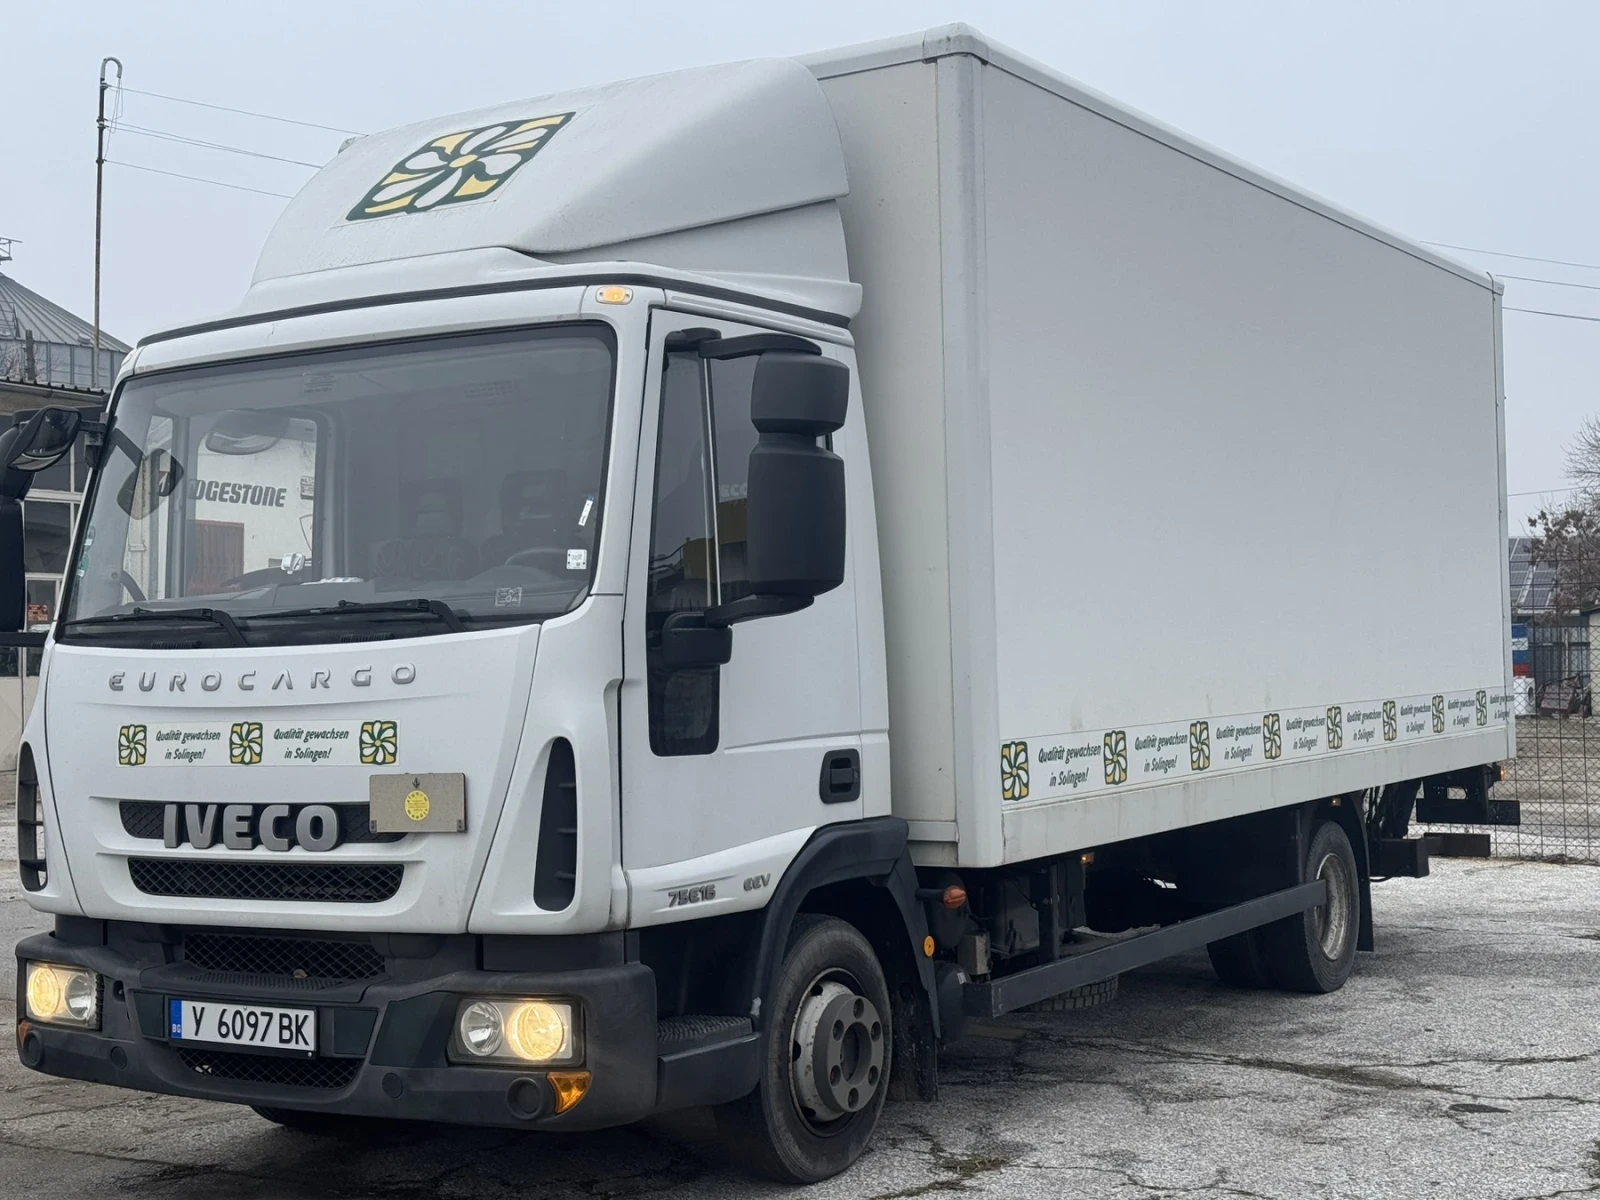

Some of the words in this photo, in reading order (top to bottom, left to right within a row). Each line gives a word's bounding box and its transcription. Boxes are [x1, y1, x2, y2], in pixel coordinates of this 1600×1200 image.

[188, 479, 288, 507] DGESTONE
[108, 663, 417, 692] EUROCARGO
[156, 729, 182, 742] Qualität
[181, 729, 221, 744] gewachsen
[273, 728, 304, 740] Qualität
[304, 728, 349, 743] gewachsen
[1135, 734, 1157, 751] Qualität
[1157, 732, 1188, 752] gewachsen
[164, 748, 172, 759] in
[173, 748, 206, 763] Solingen!
[284, 747, 292, 758] in
[294, 747, 332, 762] Solingen!
[1038, 745, 1065, 763] Qualität
[1065, 742, 1101, 764] gewachsen
[1224, 747, 1229, 760] in
[1144, 758, 1150, 772] in
[1151, 754, 1177, 774] Solingen!
[1050, 772, 1056, 787] in
[1058, 767, 1089, 788] Solingen!
[163, 803, 340, 852] IVECO
[743, 873, 771, 891] EEV
[171, 1023, 182, 1034] BG
[217, 1008, 273, 1042] 6097
[279, 1013, 310, 1046] BK
